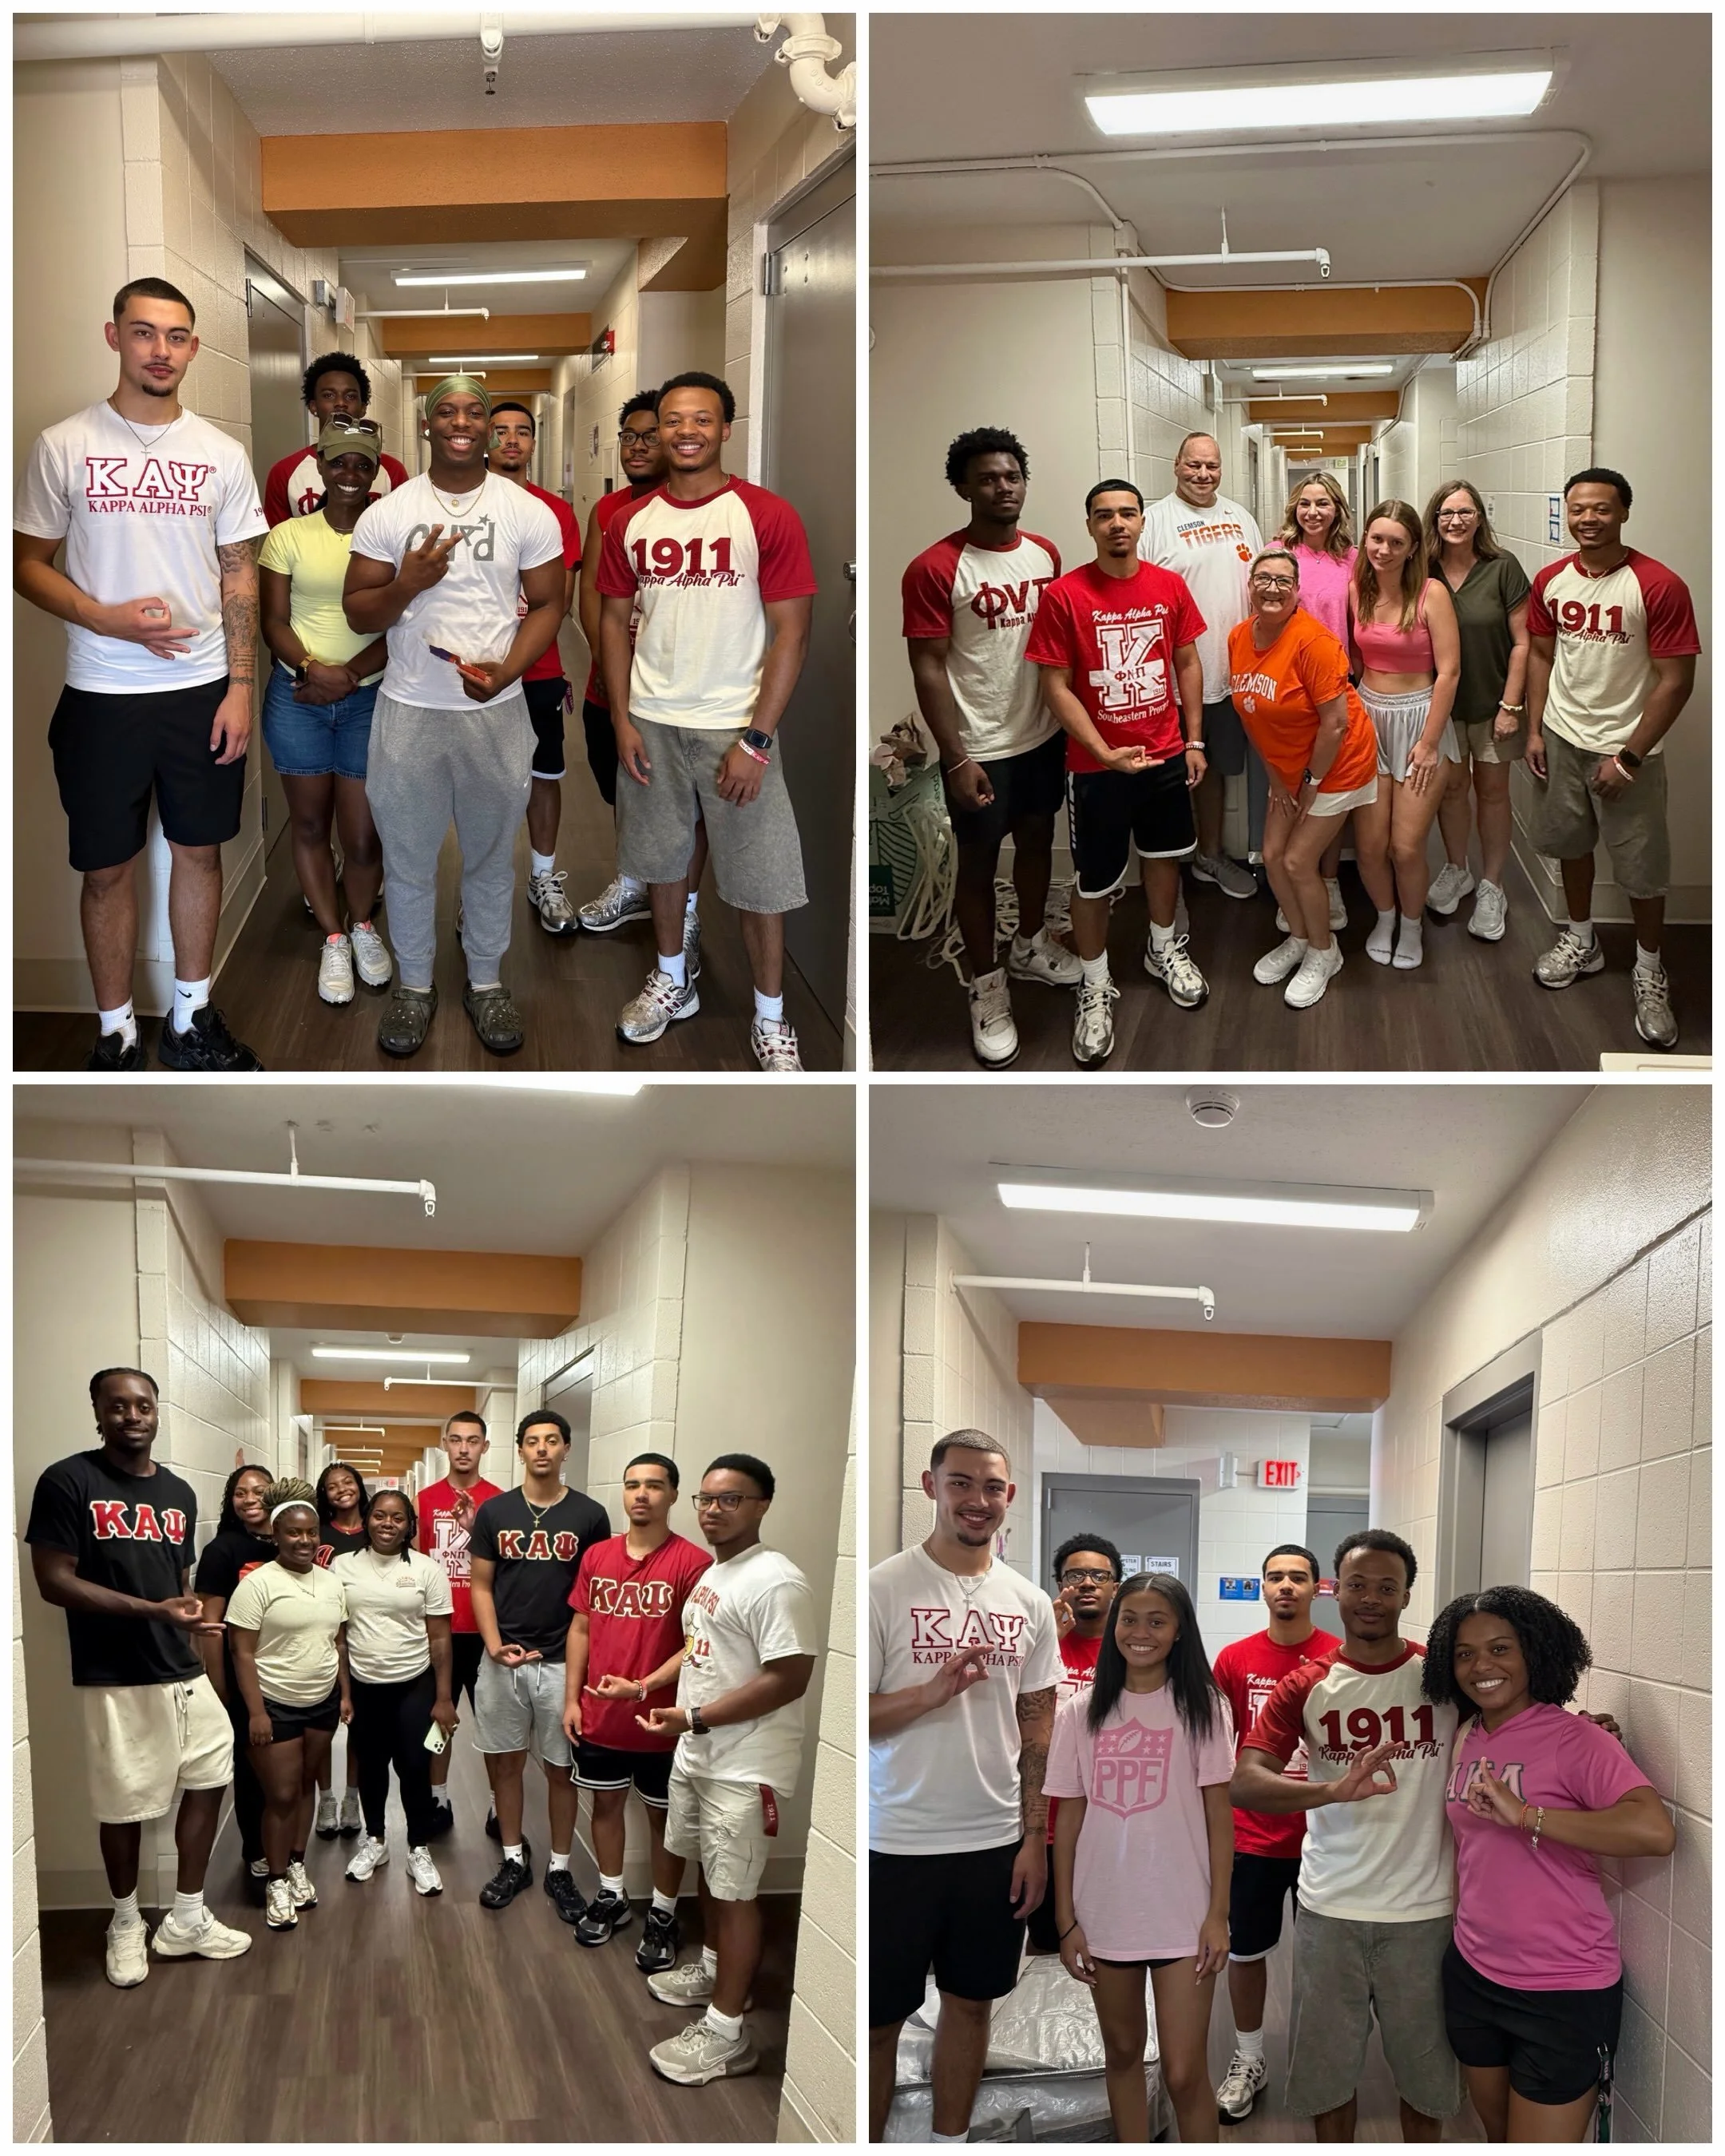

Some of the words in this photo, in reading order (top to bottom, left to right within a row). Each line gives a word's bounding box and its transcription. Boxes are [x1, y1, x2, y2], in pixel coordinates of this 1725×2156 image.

[89, 501, 135, 513] KAPPA
[140, 501, 186, 515] ALPHA
[254, 507, 263, 517] 19
[1177, 521, 1205, 533] CLEMSON
[1180, 523, 1245, 549] TIGERS
[631, 537, 735, 577] 1911
[640, 575, 664, 589] appa
[667, 573, 712, 590] Alpha
[1001, 616, 1025, 628] Kappa
[1092, 610, 1122, 624] Kappa
[1124, 607, 1152, 620] Alpha
[1548, 598, 1626, 636] 1911
[1572, 629, 1607, 643] Alpha
[1231, 672, 1277, 702] CLEMSON
[1097, 708, 1147, 723] Southeastern
[1266, 1460, 1297, 1486] EXIT
[1247, 1674, 1278, 1687] Kappa
[1319, 1705, 1437, 1753] 1911
[1319, 1746, 1354, 1765] Kapp
[1096, 1759, 1162, 1809] PPF
[767, 1804, 776, 1821] 1911
